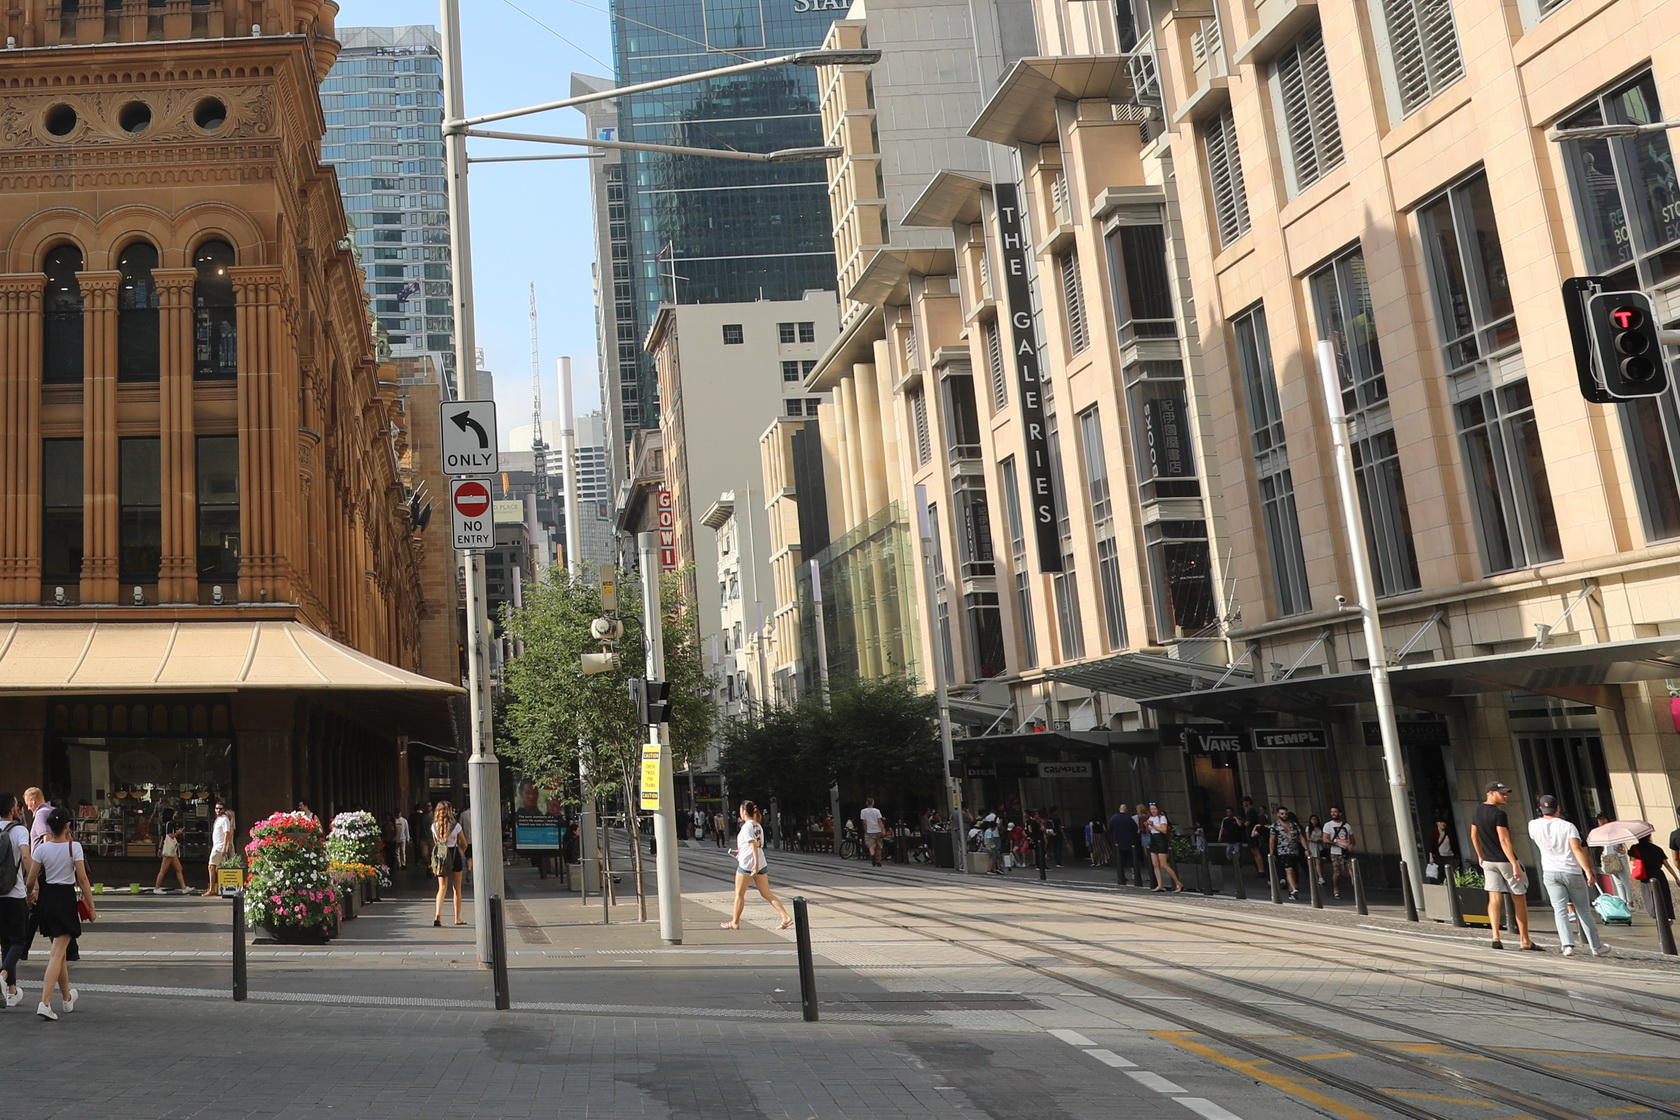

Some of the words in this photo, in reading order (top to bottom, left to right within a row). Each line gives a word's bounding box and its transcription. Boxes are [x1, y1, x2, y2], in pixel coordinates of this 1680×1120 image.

[1002, 207, 1022, 276] THE
[1013, 311, 1052, 523] GALERIES
[1144, 403, 1159, 478] BOOKS
[447, 453, 492, 467] ONLY
[463, 520, 483, 532] NO
[457, 534, 489, 544] ENTRY
[1370, 725, 1442, 734] WKSHOP
[1198, 735, 1242, 752] VANS
[1043, 765, 1088, 774] CRUMPLER
